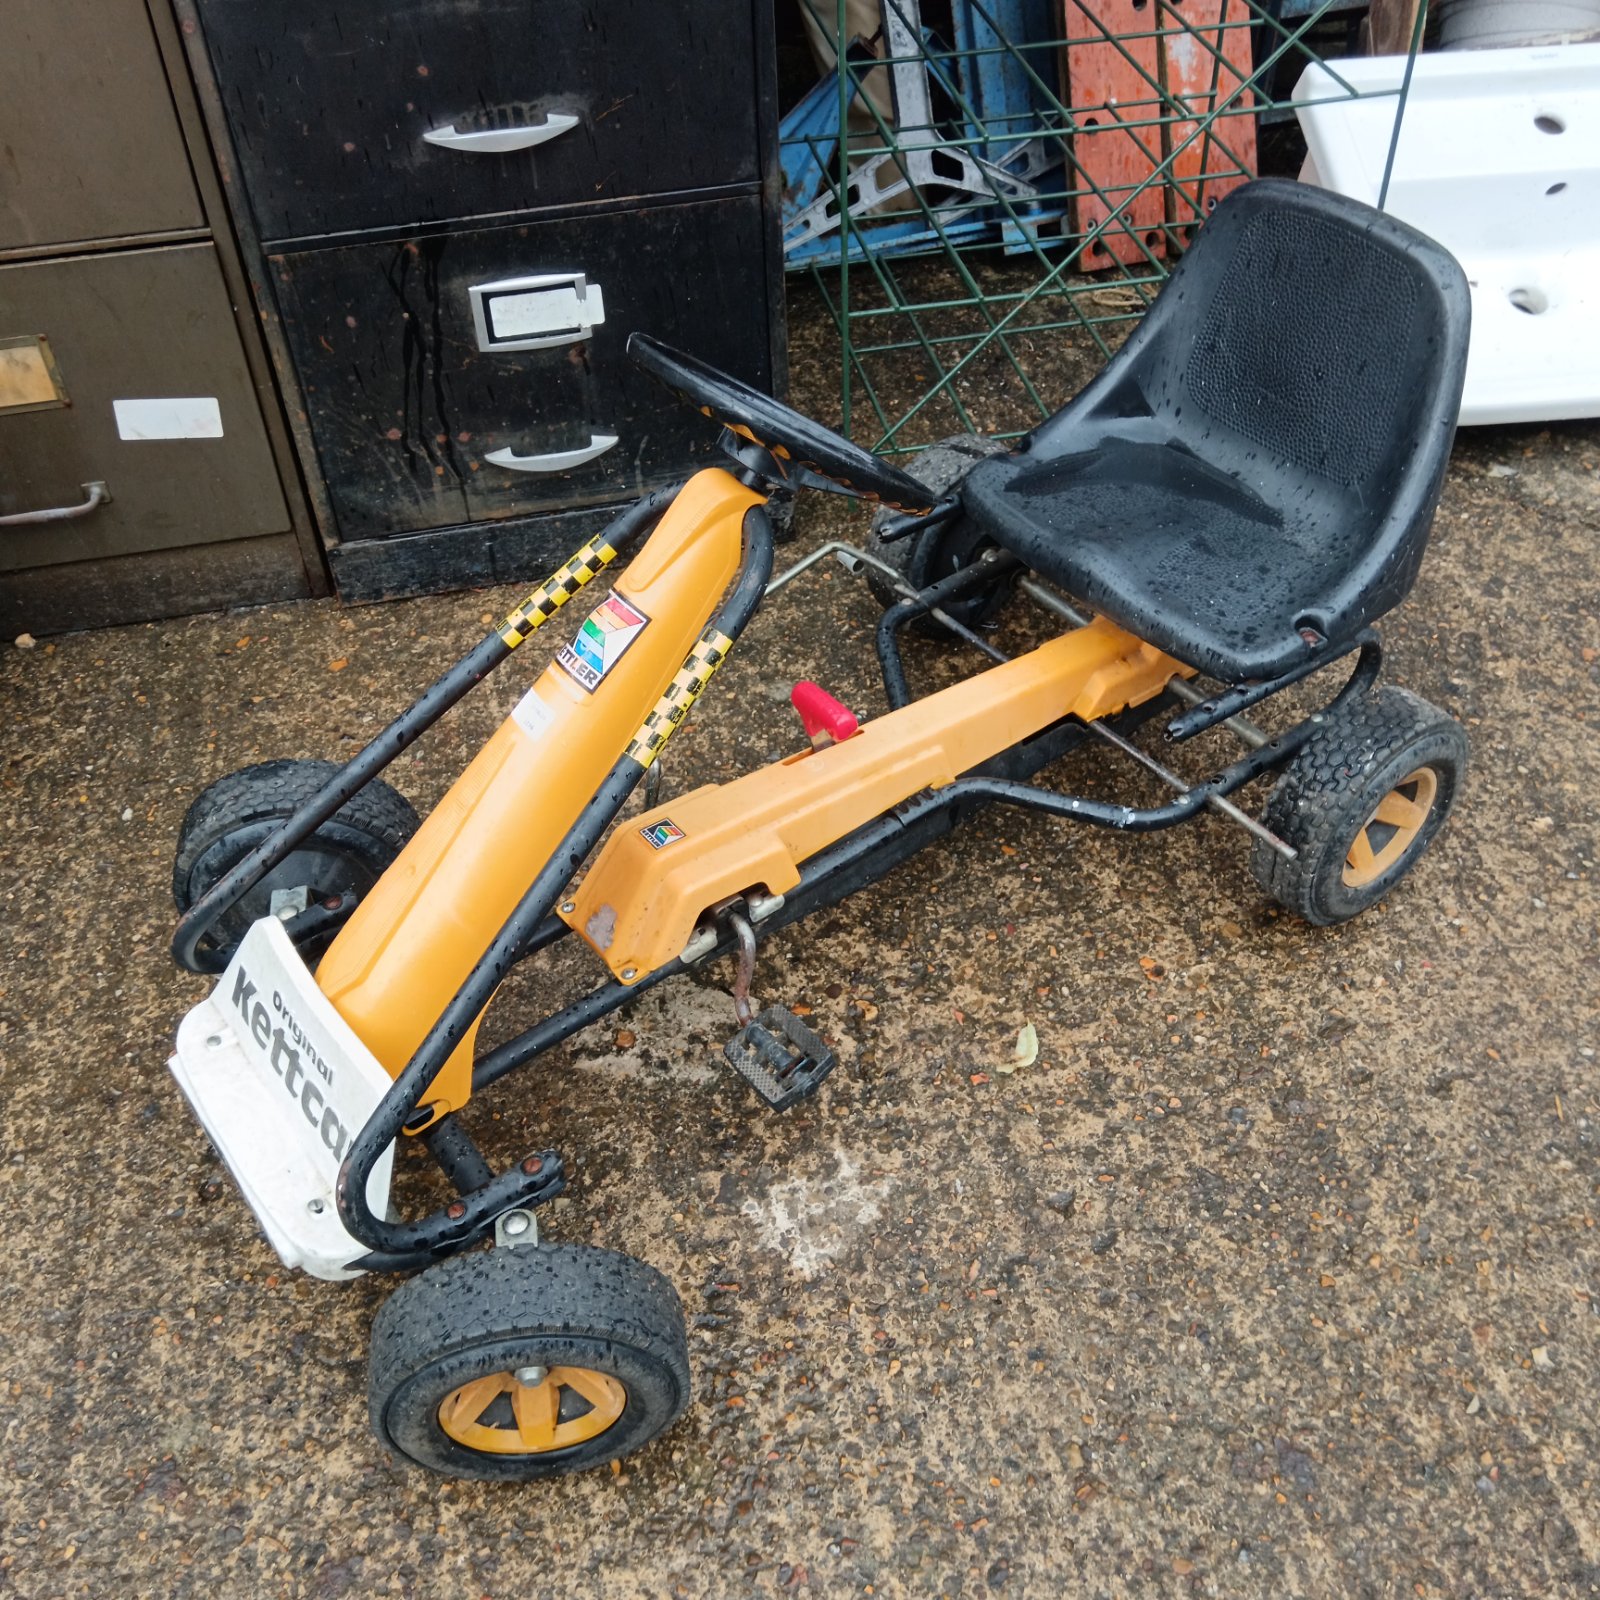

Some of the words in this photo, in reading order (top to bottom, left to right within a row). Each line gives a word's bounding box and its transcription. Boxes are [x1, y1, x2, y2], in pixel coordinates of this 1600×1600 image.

[560, 645, 599, 686] ETTLER
[232, 965, 352, 1163] Kettca
[272, 990, 334, 1087] Original
